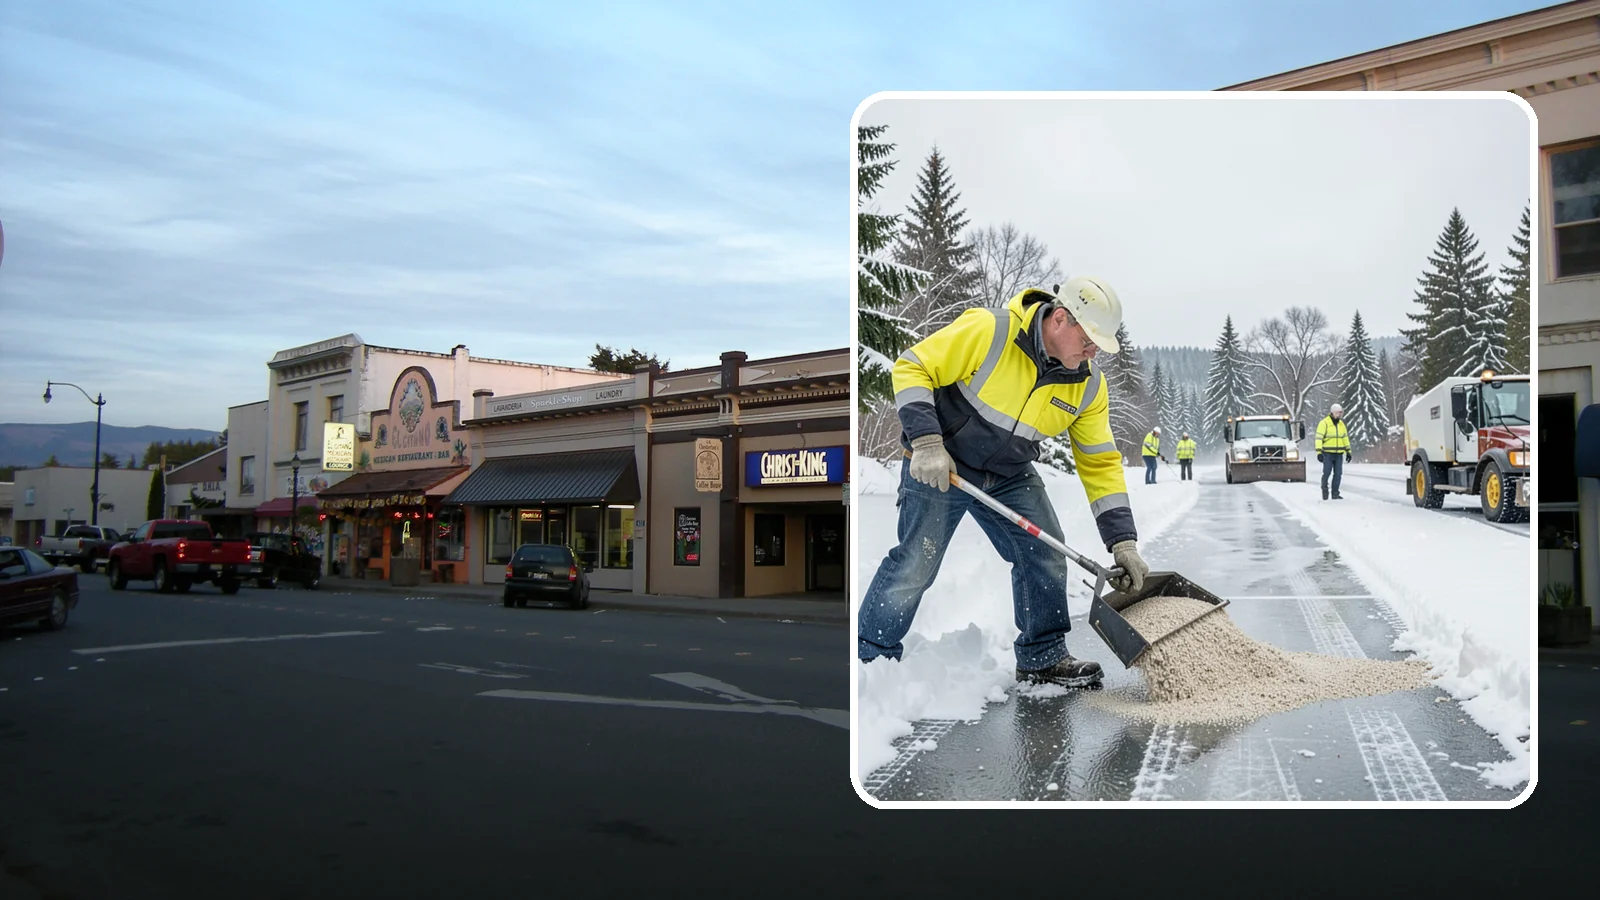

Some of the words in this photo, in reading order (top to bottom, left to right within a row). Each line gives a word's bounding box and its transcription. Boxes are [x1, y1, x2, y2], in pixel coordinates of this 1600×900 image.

[596, 389, 623, 400] LAUNDRY
[493, 402, 522, 413] LAVANDERIA
[530, 398, 560, 409] Sparkle
[562, 395, 582, 405] Shop
[373, 454, 396, 464] MEXICAN
[397, 451, 433, 463] RESTAURANT
[438, 450, 450, 459] BAR
[697, 480, 709, 489] Coffee
[710, 480, 722, 489] House
